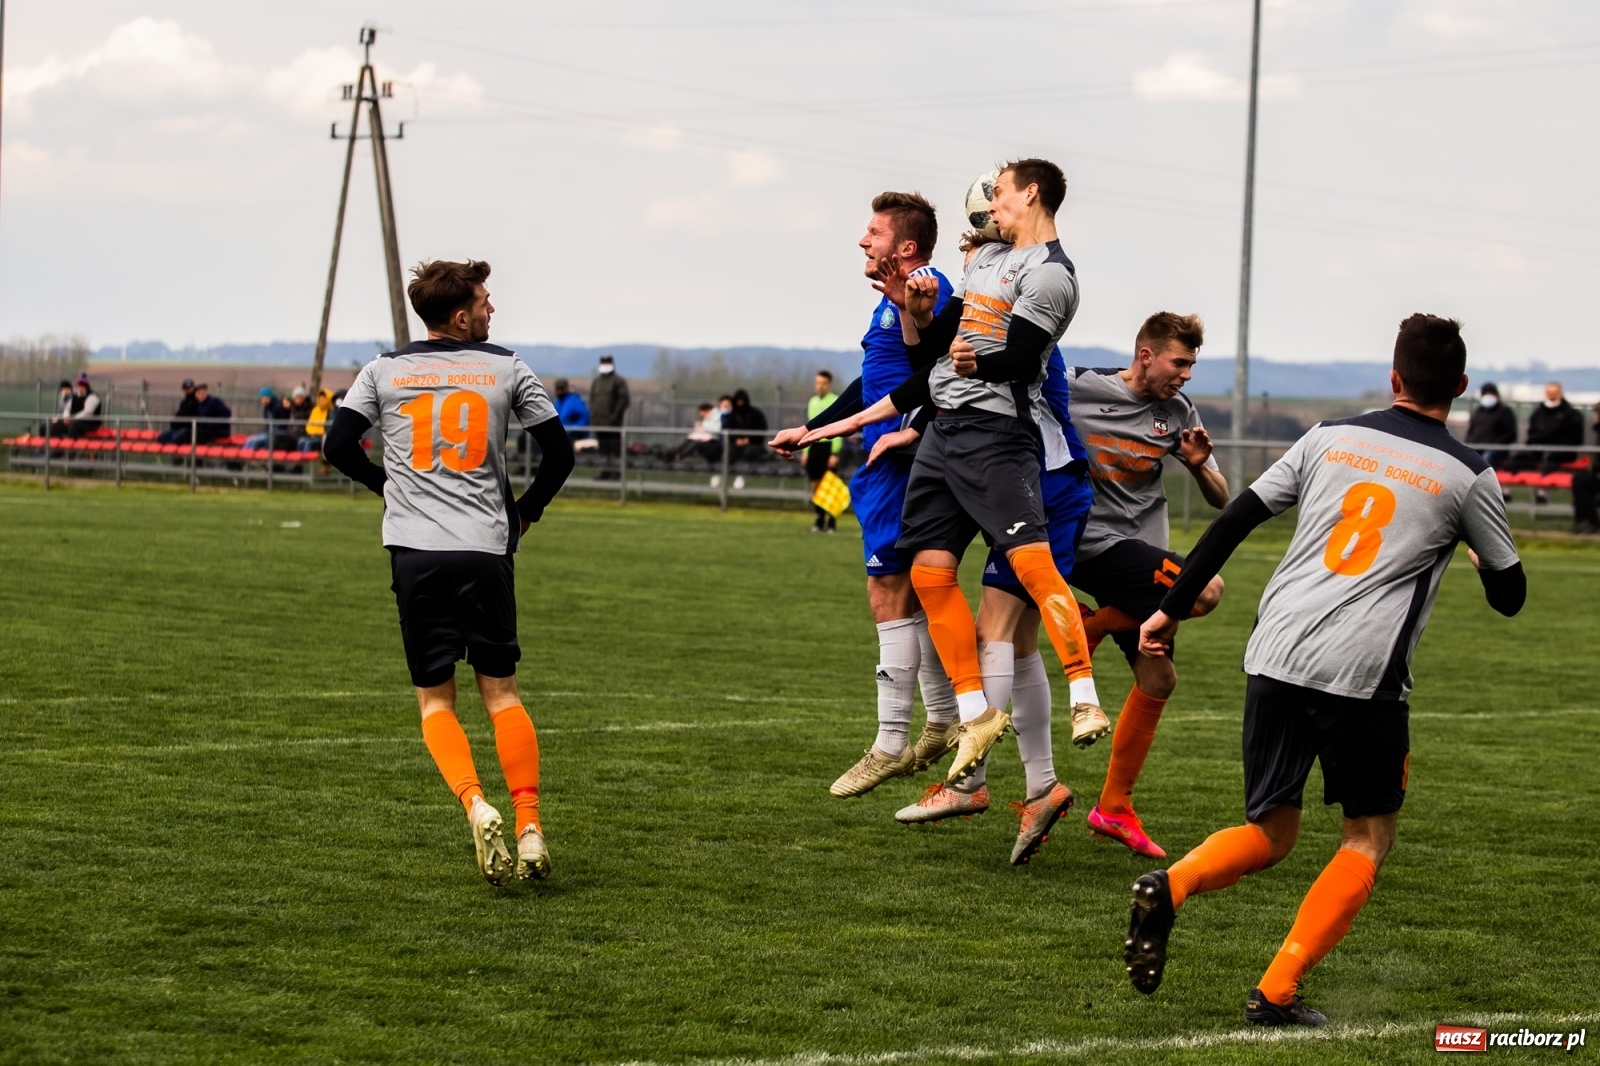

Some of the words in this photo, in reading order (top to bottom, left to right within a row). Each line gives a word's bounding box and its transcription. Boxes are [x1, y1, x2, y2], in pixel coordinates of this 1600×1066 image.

[392, 374, 441, 387] NAPRZÓD
[447, 374, 496, 386] BORUCIN
[400, 390, 489, 472] 19
[1154, 421, 1168, 431] KS
[1325, 449, 1379, 474] NAPRZÓD
[1384, 465, 1444, 497] BORUCIN
[1338, 436, 1371, 449] KLUB
[1373, 445, 1446, 473] SPORTOWY
[1323, 481, 1397, 577] 8
